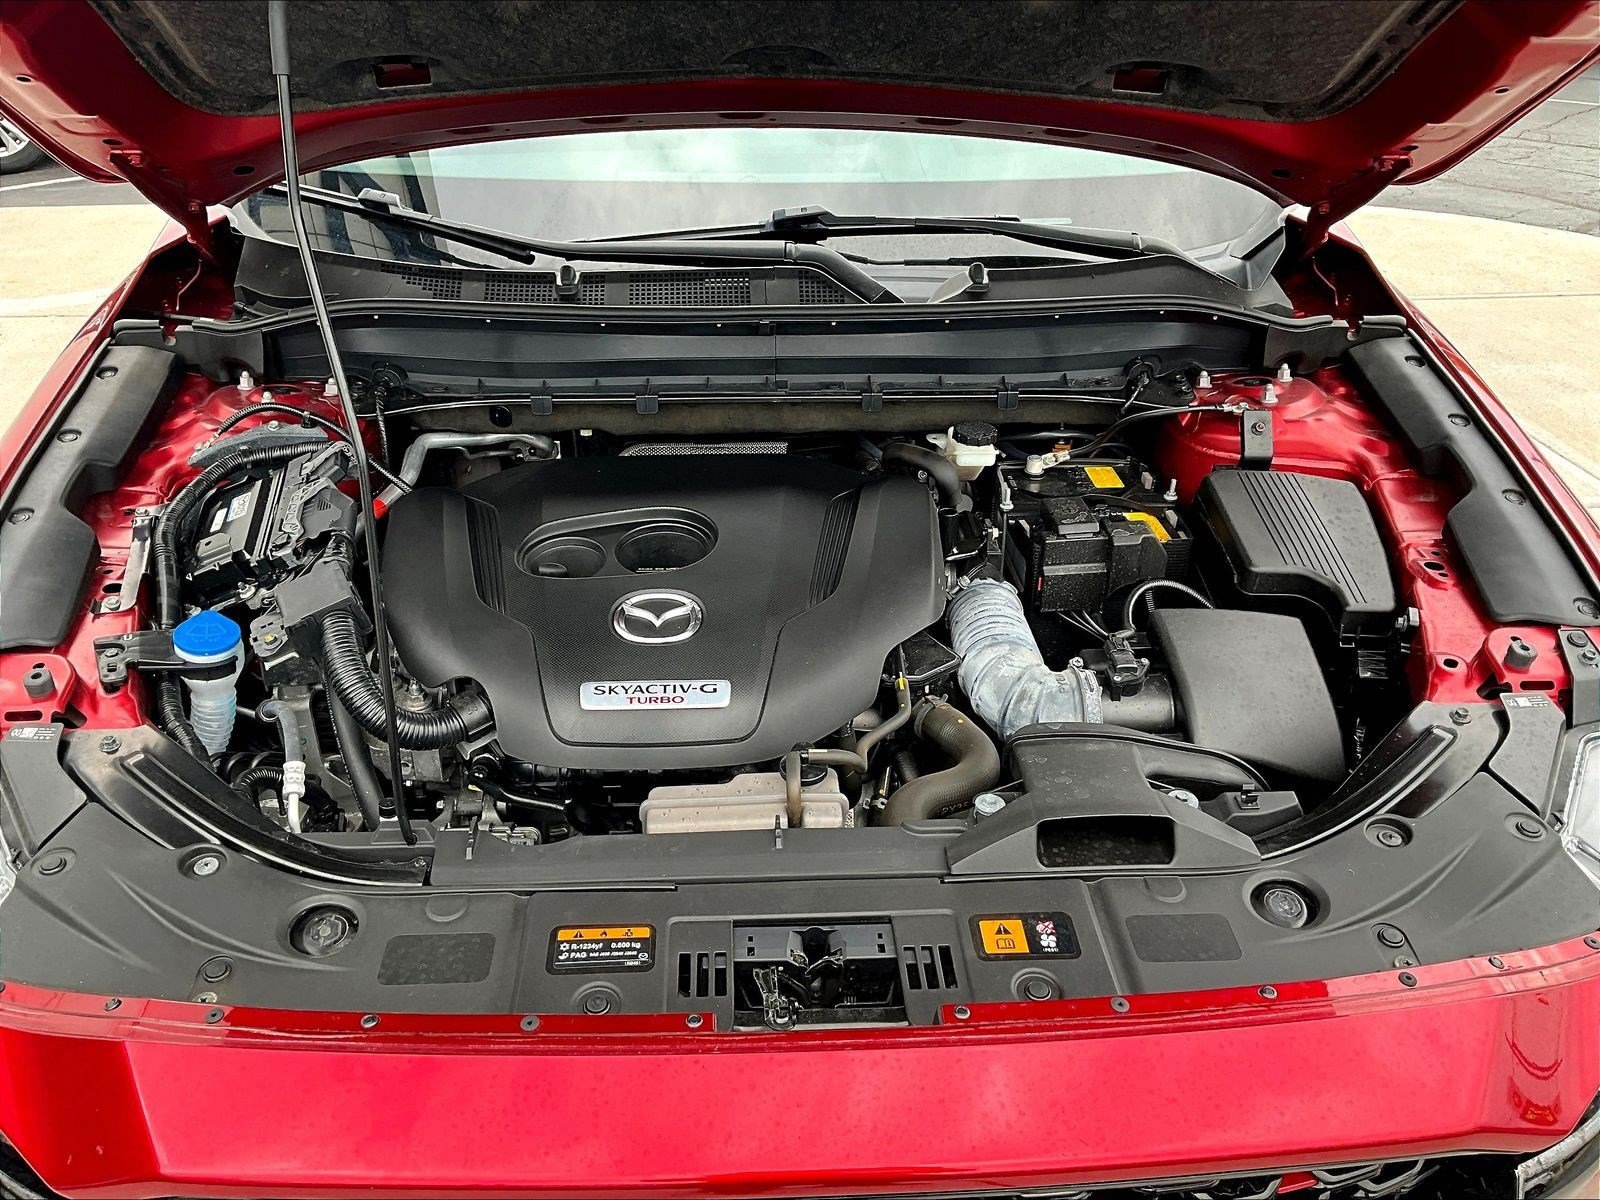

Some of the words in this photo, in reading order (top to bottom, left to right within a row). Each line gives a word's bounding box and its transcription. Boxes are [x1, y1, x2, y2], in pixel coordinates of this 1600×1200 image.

[593, 683, 718, 695] SKYACTIV-G
[626, 695, 685, 705] TURBO
[631, 941, 641, 949] kg
